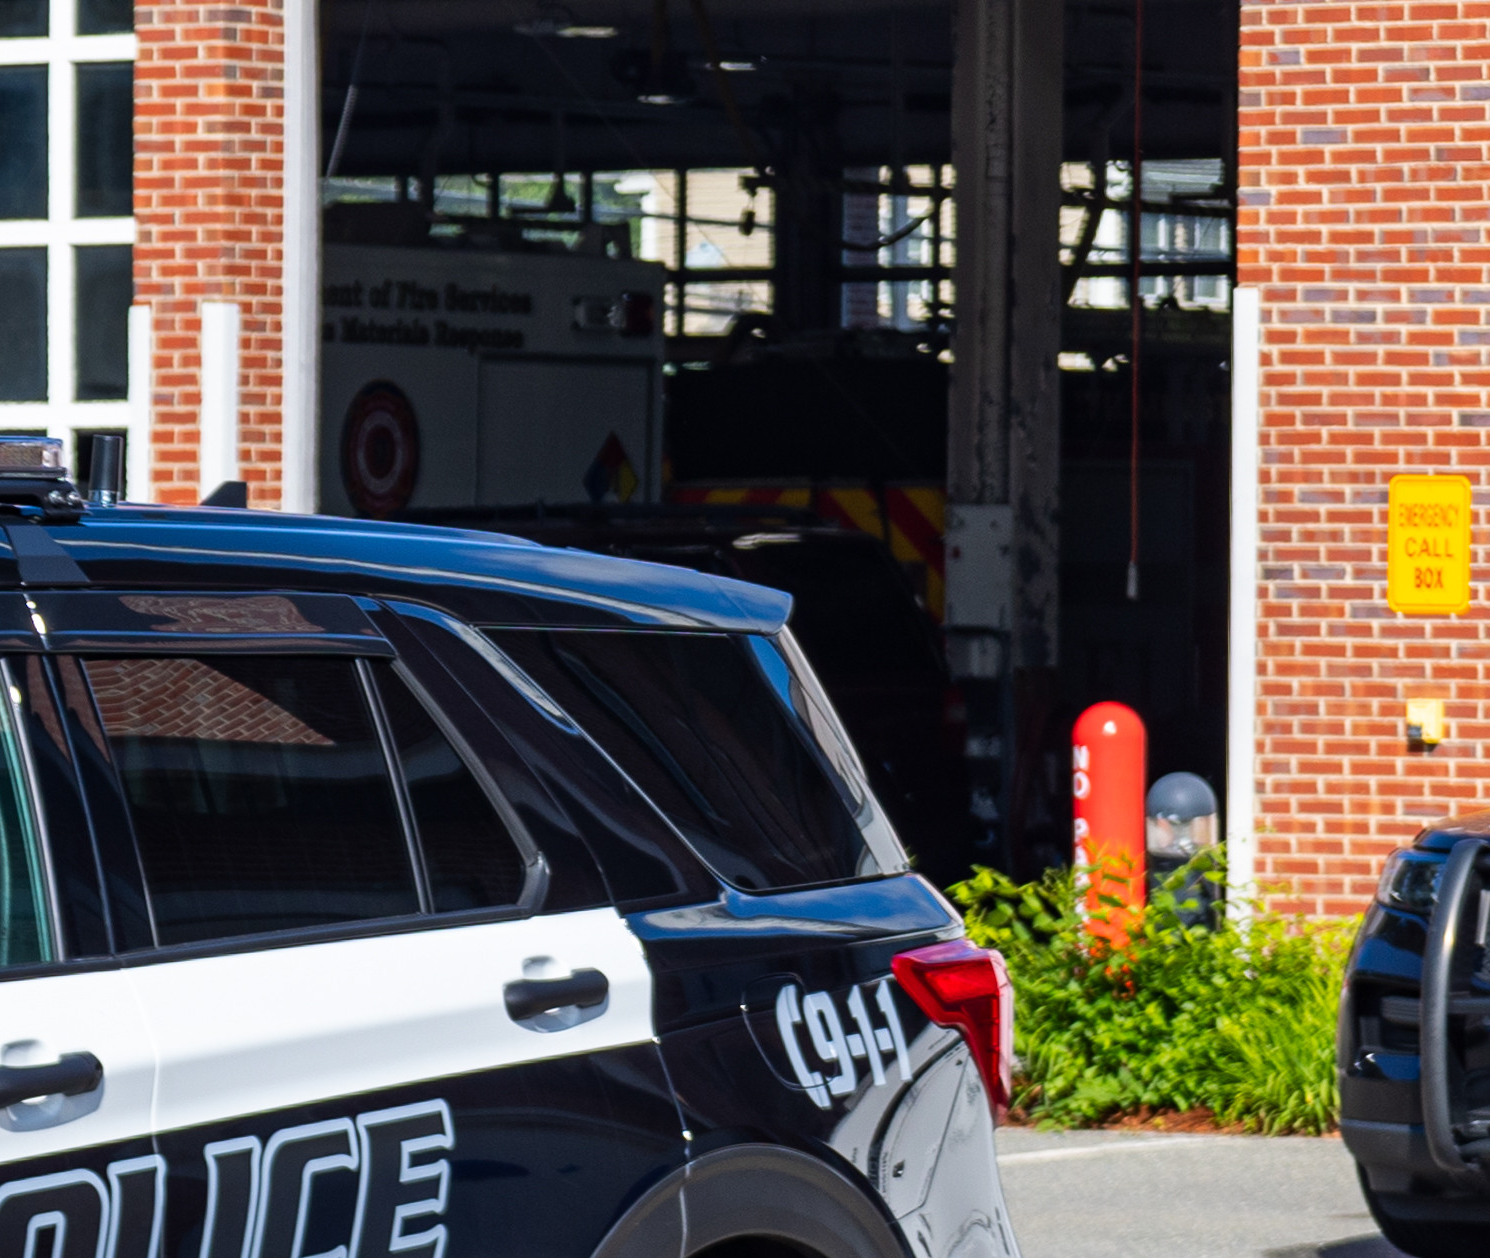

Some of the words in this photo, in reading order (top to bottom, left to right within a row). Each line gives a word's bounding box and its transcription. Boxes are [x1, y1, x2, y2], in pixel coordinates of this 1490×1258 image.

[1398, 503, 1459, 529] EMERGENCY
[1404, 535, 1454, 560] CALL
[1414, 566, 1445, 590] BOX
